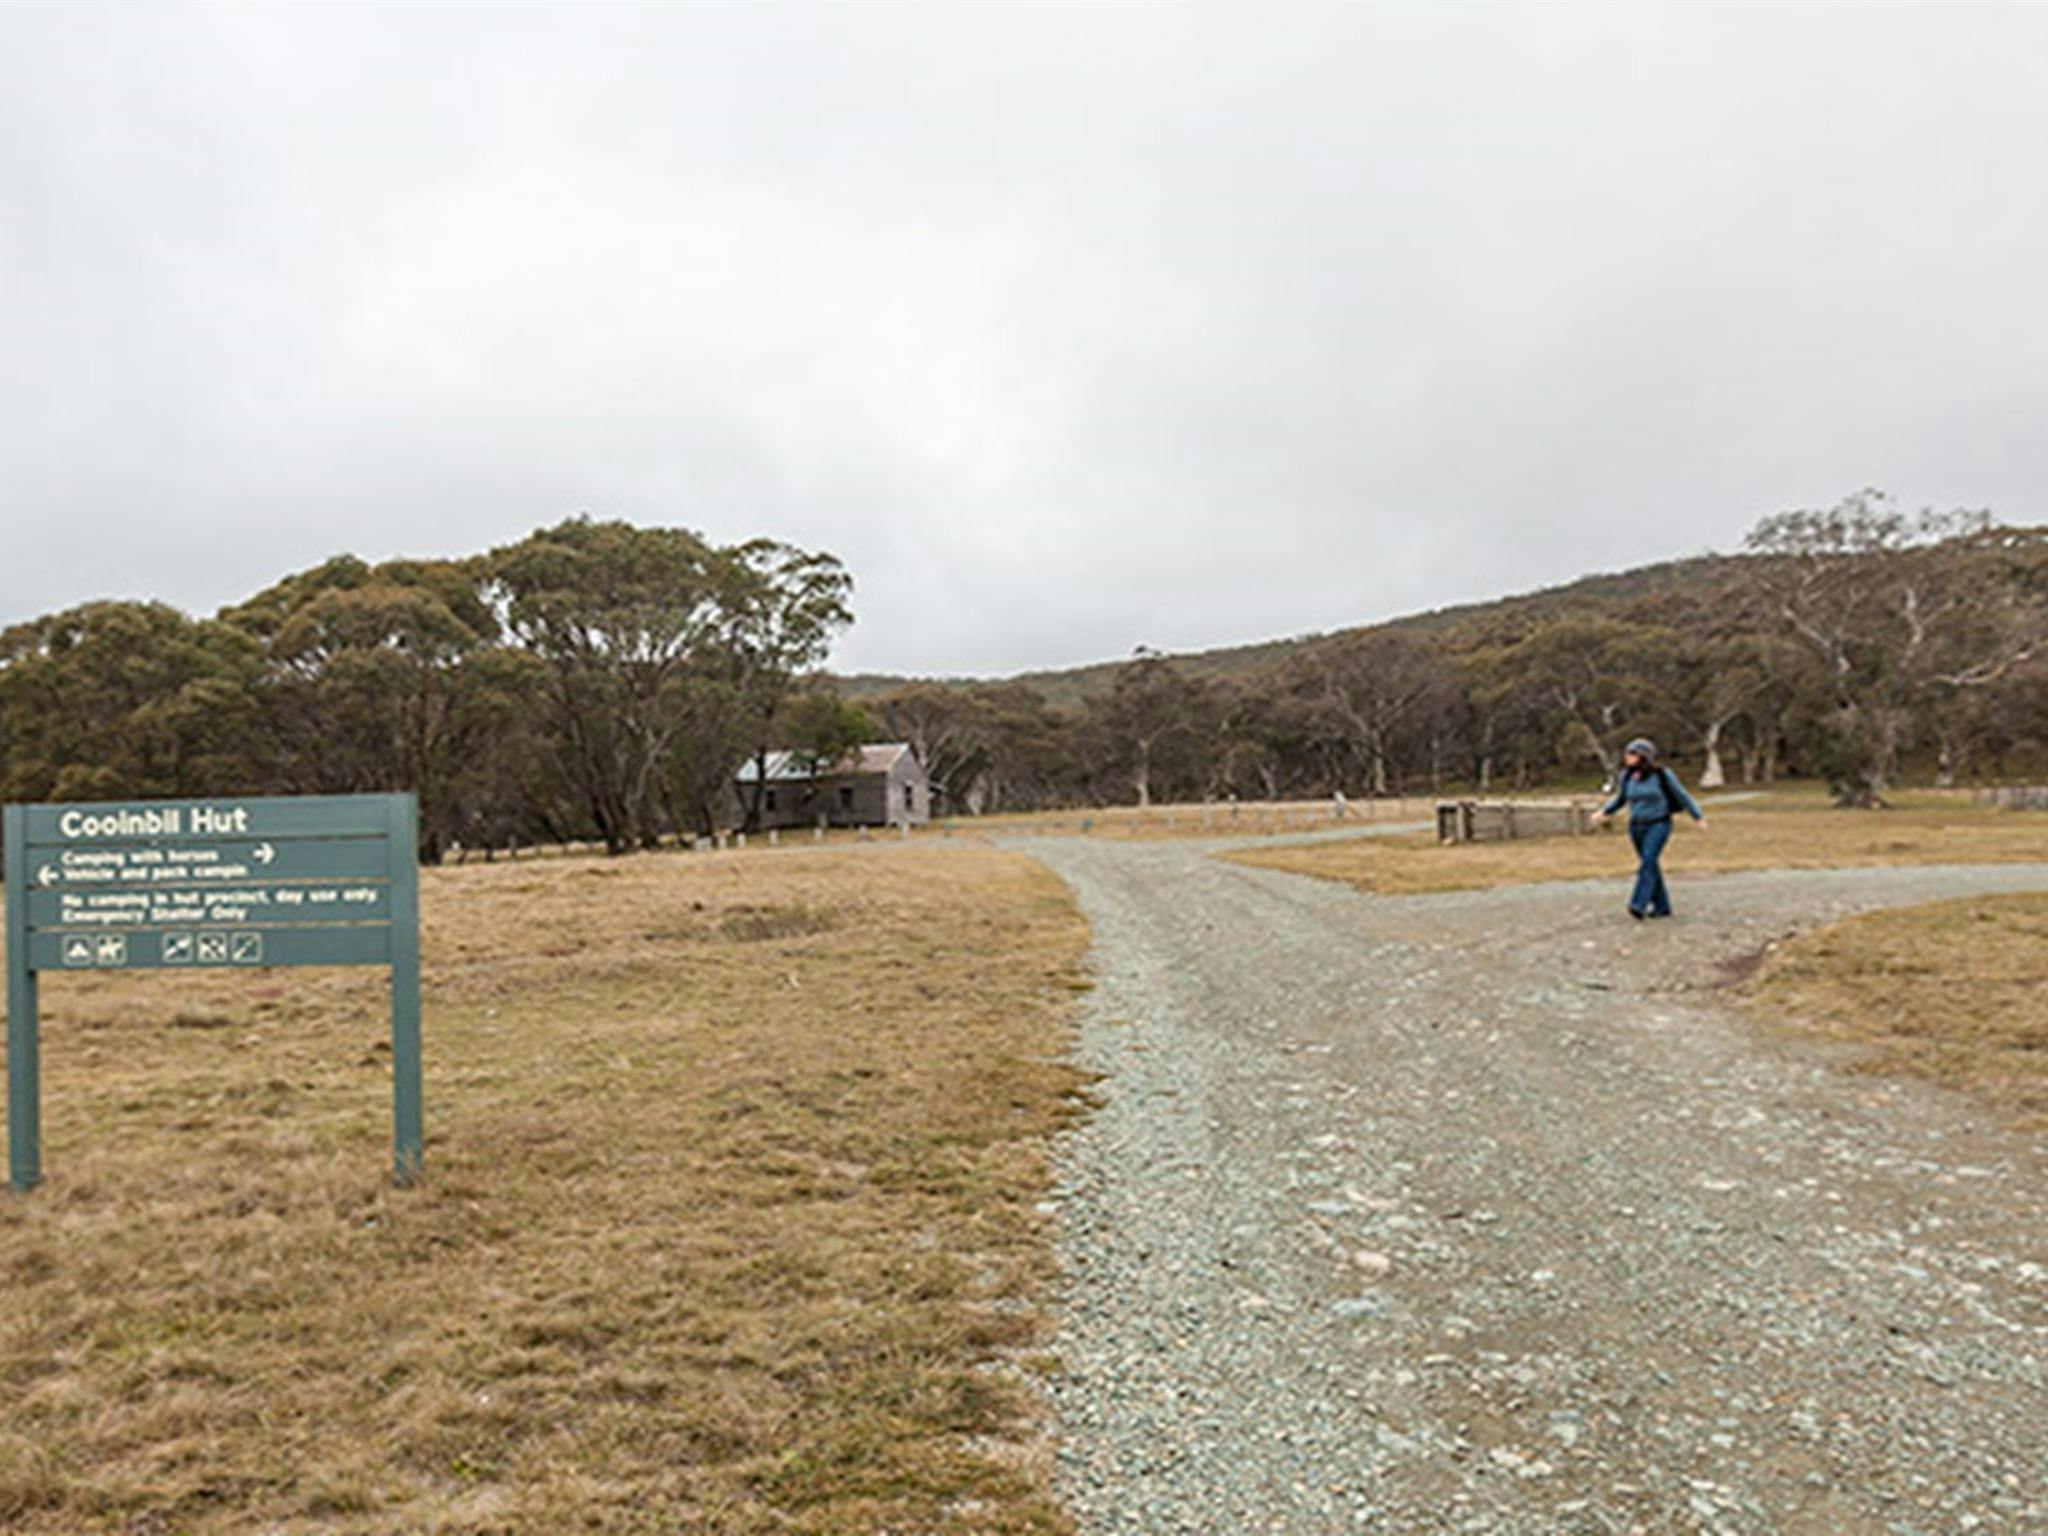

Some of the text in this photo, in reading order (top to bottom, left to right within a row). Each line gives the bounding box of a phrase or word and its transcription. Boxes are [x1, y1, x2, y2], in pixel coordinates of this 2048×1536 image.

[191, 807, 248, 834] Hut
[61, 850, 219, 867] Camping with horses
[62, 866, 114, 880] Vehicle
[120, 866, 148, 879] and
[88, 892, 150, 909] camping
[154, 893, 168, 905] in
[173, 891, 199, 904] hut
[275, 889, 303, 905] day
[309, 890, 337, 902] use
[61, 905, 248, 925] Emergency Shelter Only
